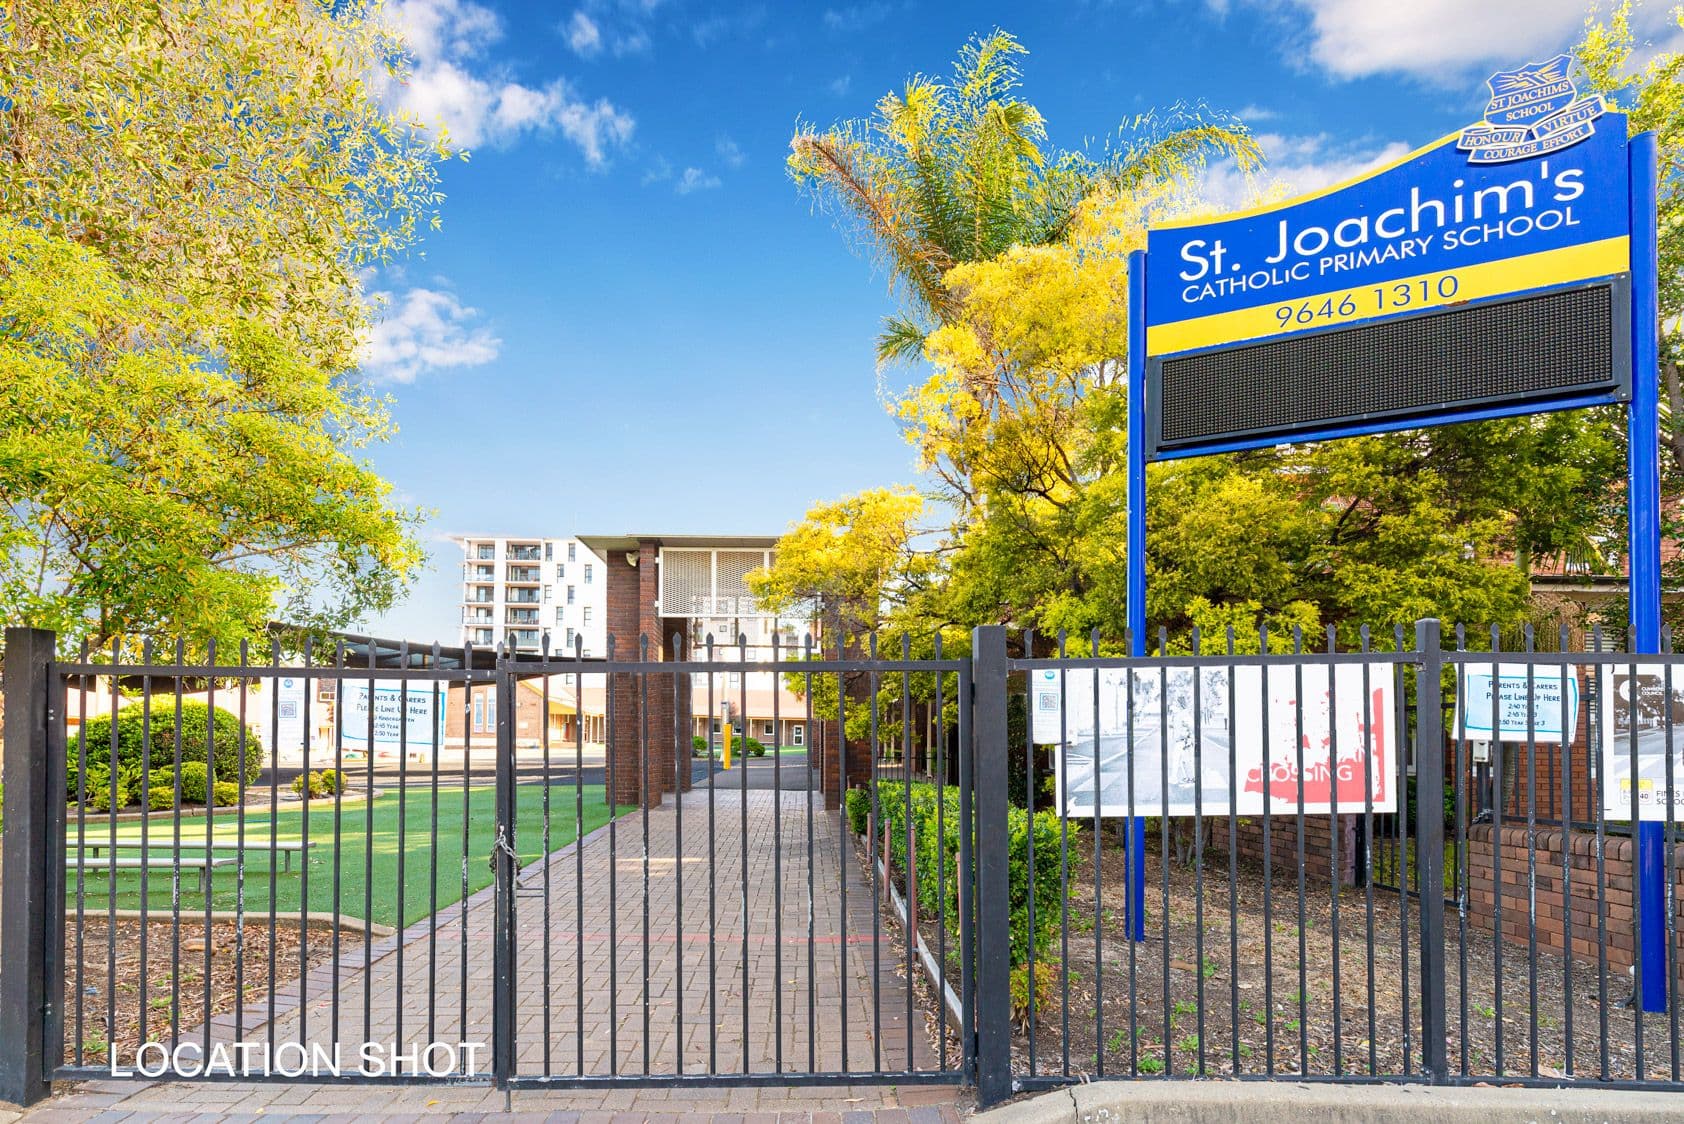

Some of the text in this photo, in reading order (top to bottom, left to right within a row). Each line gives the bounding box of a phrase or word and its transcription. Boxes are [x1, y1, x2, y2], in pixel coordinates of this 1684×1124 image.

[1491, 81, 1569, 110] ST JOACHIMS
[1506, 102, 1554, 121] SCHOOL
[1542, 106, 1597, 131] VIRTUE
[1464, 131, 1522, 146] HONOUR
[1484, 127, 1584, 159] COURAGE EFFORT
[1179, 160, 1585, 281] St. Joachim's
[1182, 207, 1580, 303] CATHOLIC PRIMARY SCHOOL
[1276, 275, 1459, 328] 9646 1310
[1486, 692, 1512, 700] PASE
[1488, 681, 1520, 689] PRENTS
[357, 703, 380, 712] PLEE
[359, 692, 388, 701] PANTS
[398, 695, 426, 704] CRERS
